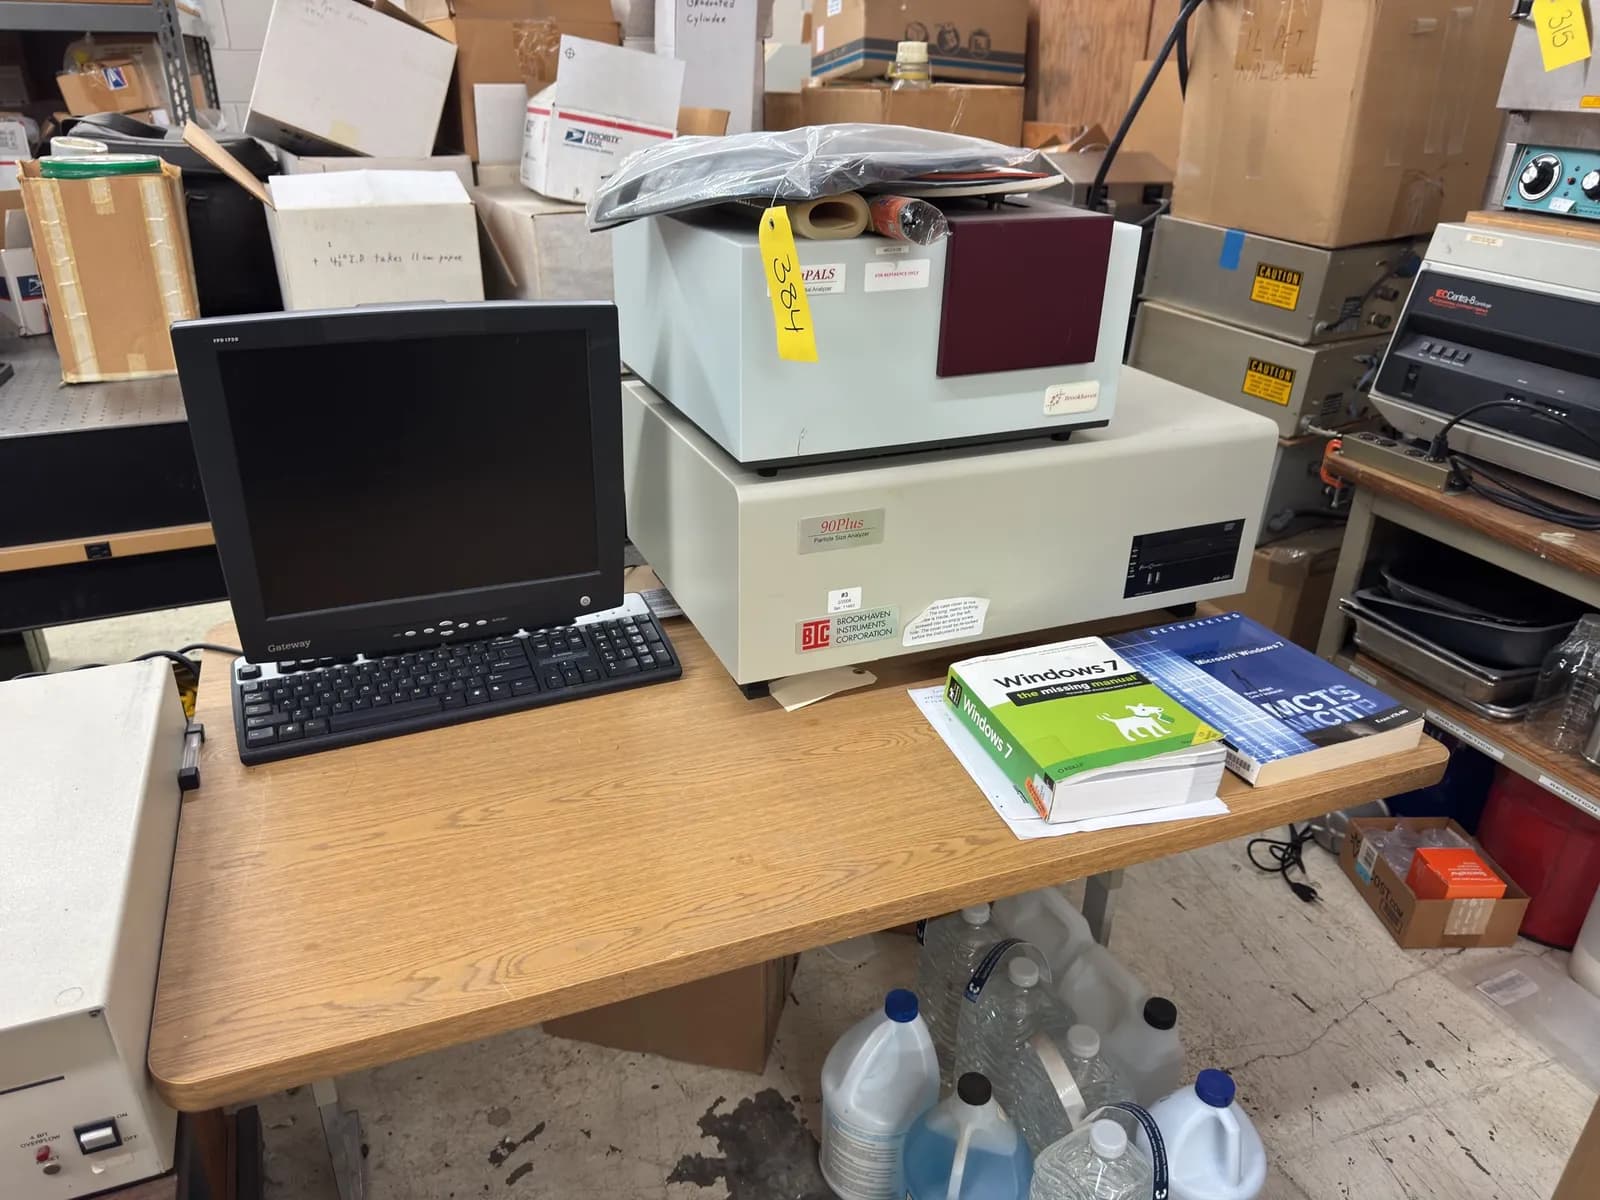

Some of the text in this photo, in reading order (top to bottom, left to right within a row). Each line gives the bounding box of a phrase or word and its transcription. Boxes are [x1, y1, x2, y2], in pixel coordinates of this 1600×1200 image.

[1548, 9, 1575, 48] 315
[586, 131, 620, 144] PRIORITY
[1259, 265, 1300, 285] CAUTION
[773, 254, 805, 333] 384
[1251, 360, 1292, 381] CAUTION
[821, 517, 864, 534] 90Plus
[813, 536, 833, 544] Particle
[848, 531, 870, 539] Analyzer
[836, 620, 887, 635] INSTRUMENTS
[837, 610, 892, 625] BROOKHAVEN
[1149, 612, 1241, 635] NETWORKING
[268, 639, 312, 653] Gateway
[836, 628, 893, 644] CORPORATION
[1194, 652, 1237, 665] Microsoft
[1238, 645, 1277, 657] Windows
[994, 663, 1104, 689] Windows
[1104, 659, 1119, 671] 7
[1016, 688, 1039, 700] the
[1040, 681, 1089, 697] missing
[1091, 674, 1136, 689] manual
[1261, 684, 1361, 720] MCTS
[962, 694, 1014, 760] Windows 7
[1550, 781, 1598, 813] RETENTION
[116, 1111, 128, 1119] ON
[20, 1134, 61, 1148] OVERFLOW
[123, 1134, 138, 1142] OFF
